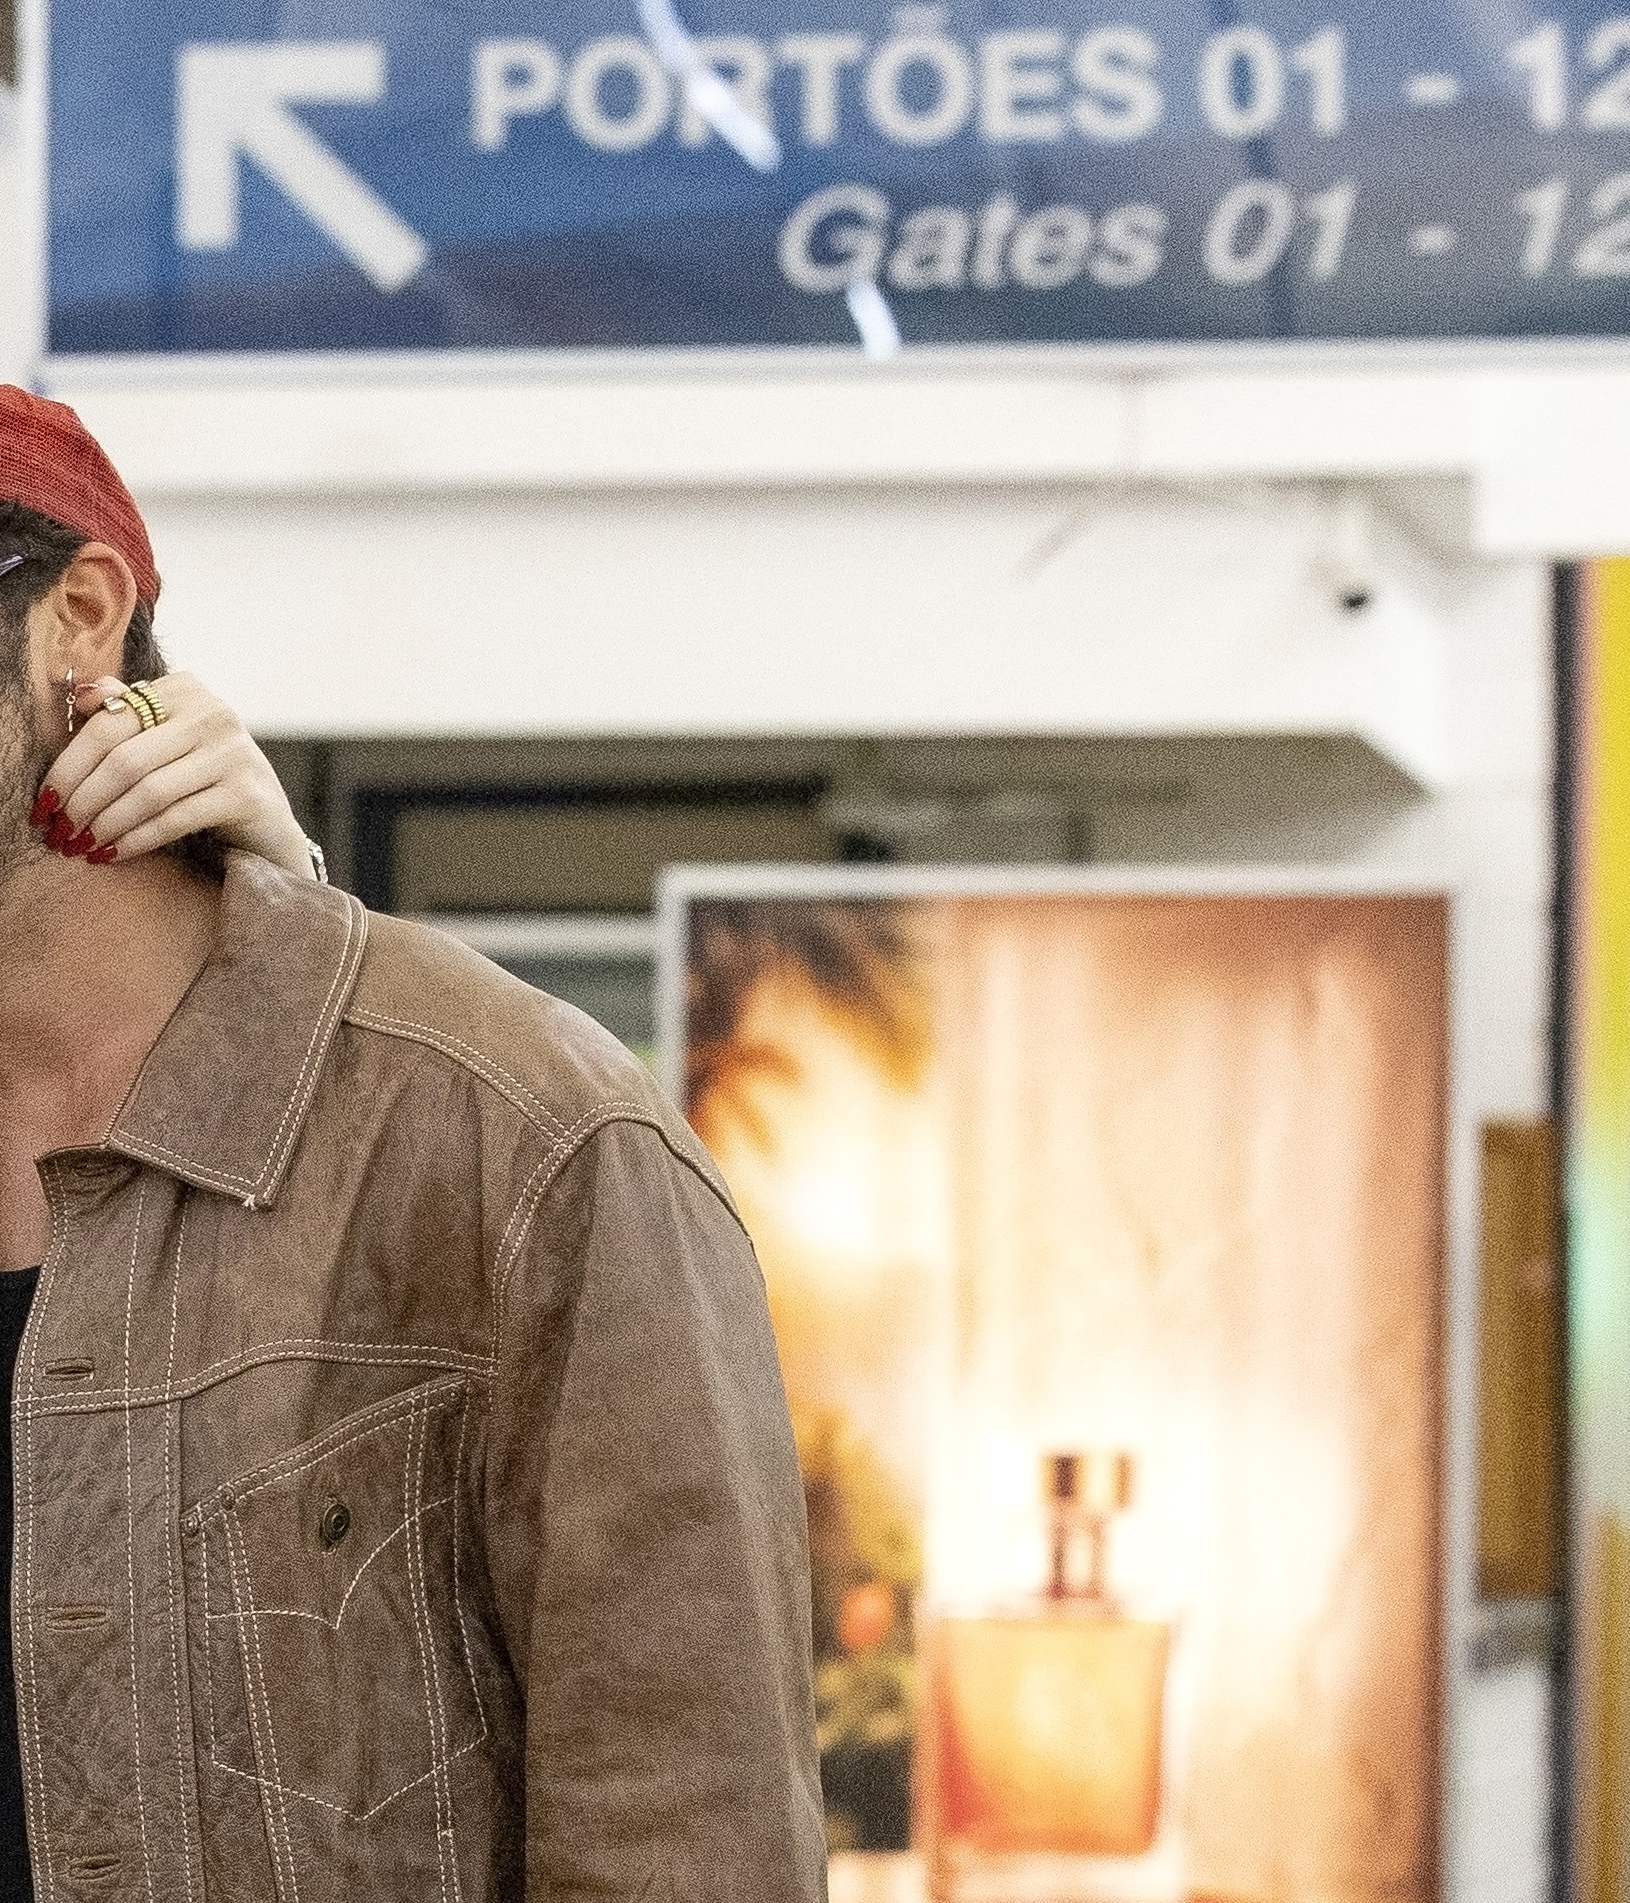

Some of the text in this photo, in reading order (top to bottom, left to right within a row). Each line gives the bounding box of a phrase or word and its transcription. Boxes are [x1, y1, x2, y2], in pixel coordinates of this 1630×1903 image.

[470, 6, 1164, 152] PORTÕES
[1200, 24, 1346, 139] 01
[1404, 71, 1462, 104] -
[777, 181, 1168, 293] Gates
[1202, 177, 1358, 286] 01
[1407, 223, 1459, 255] -
